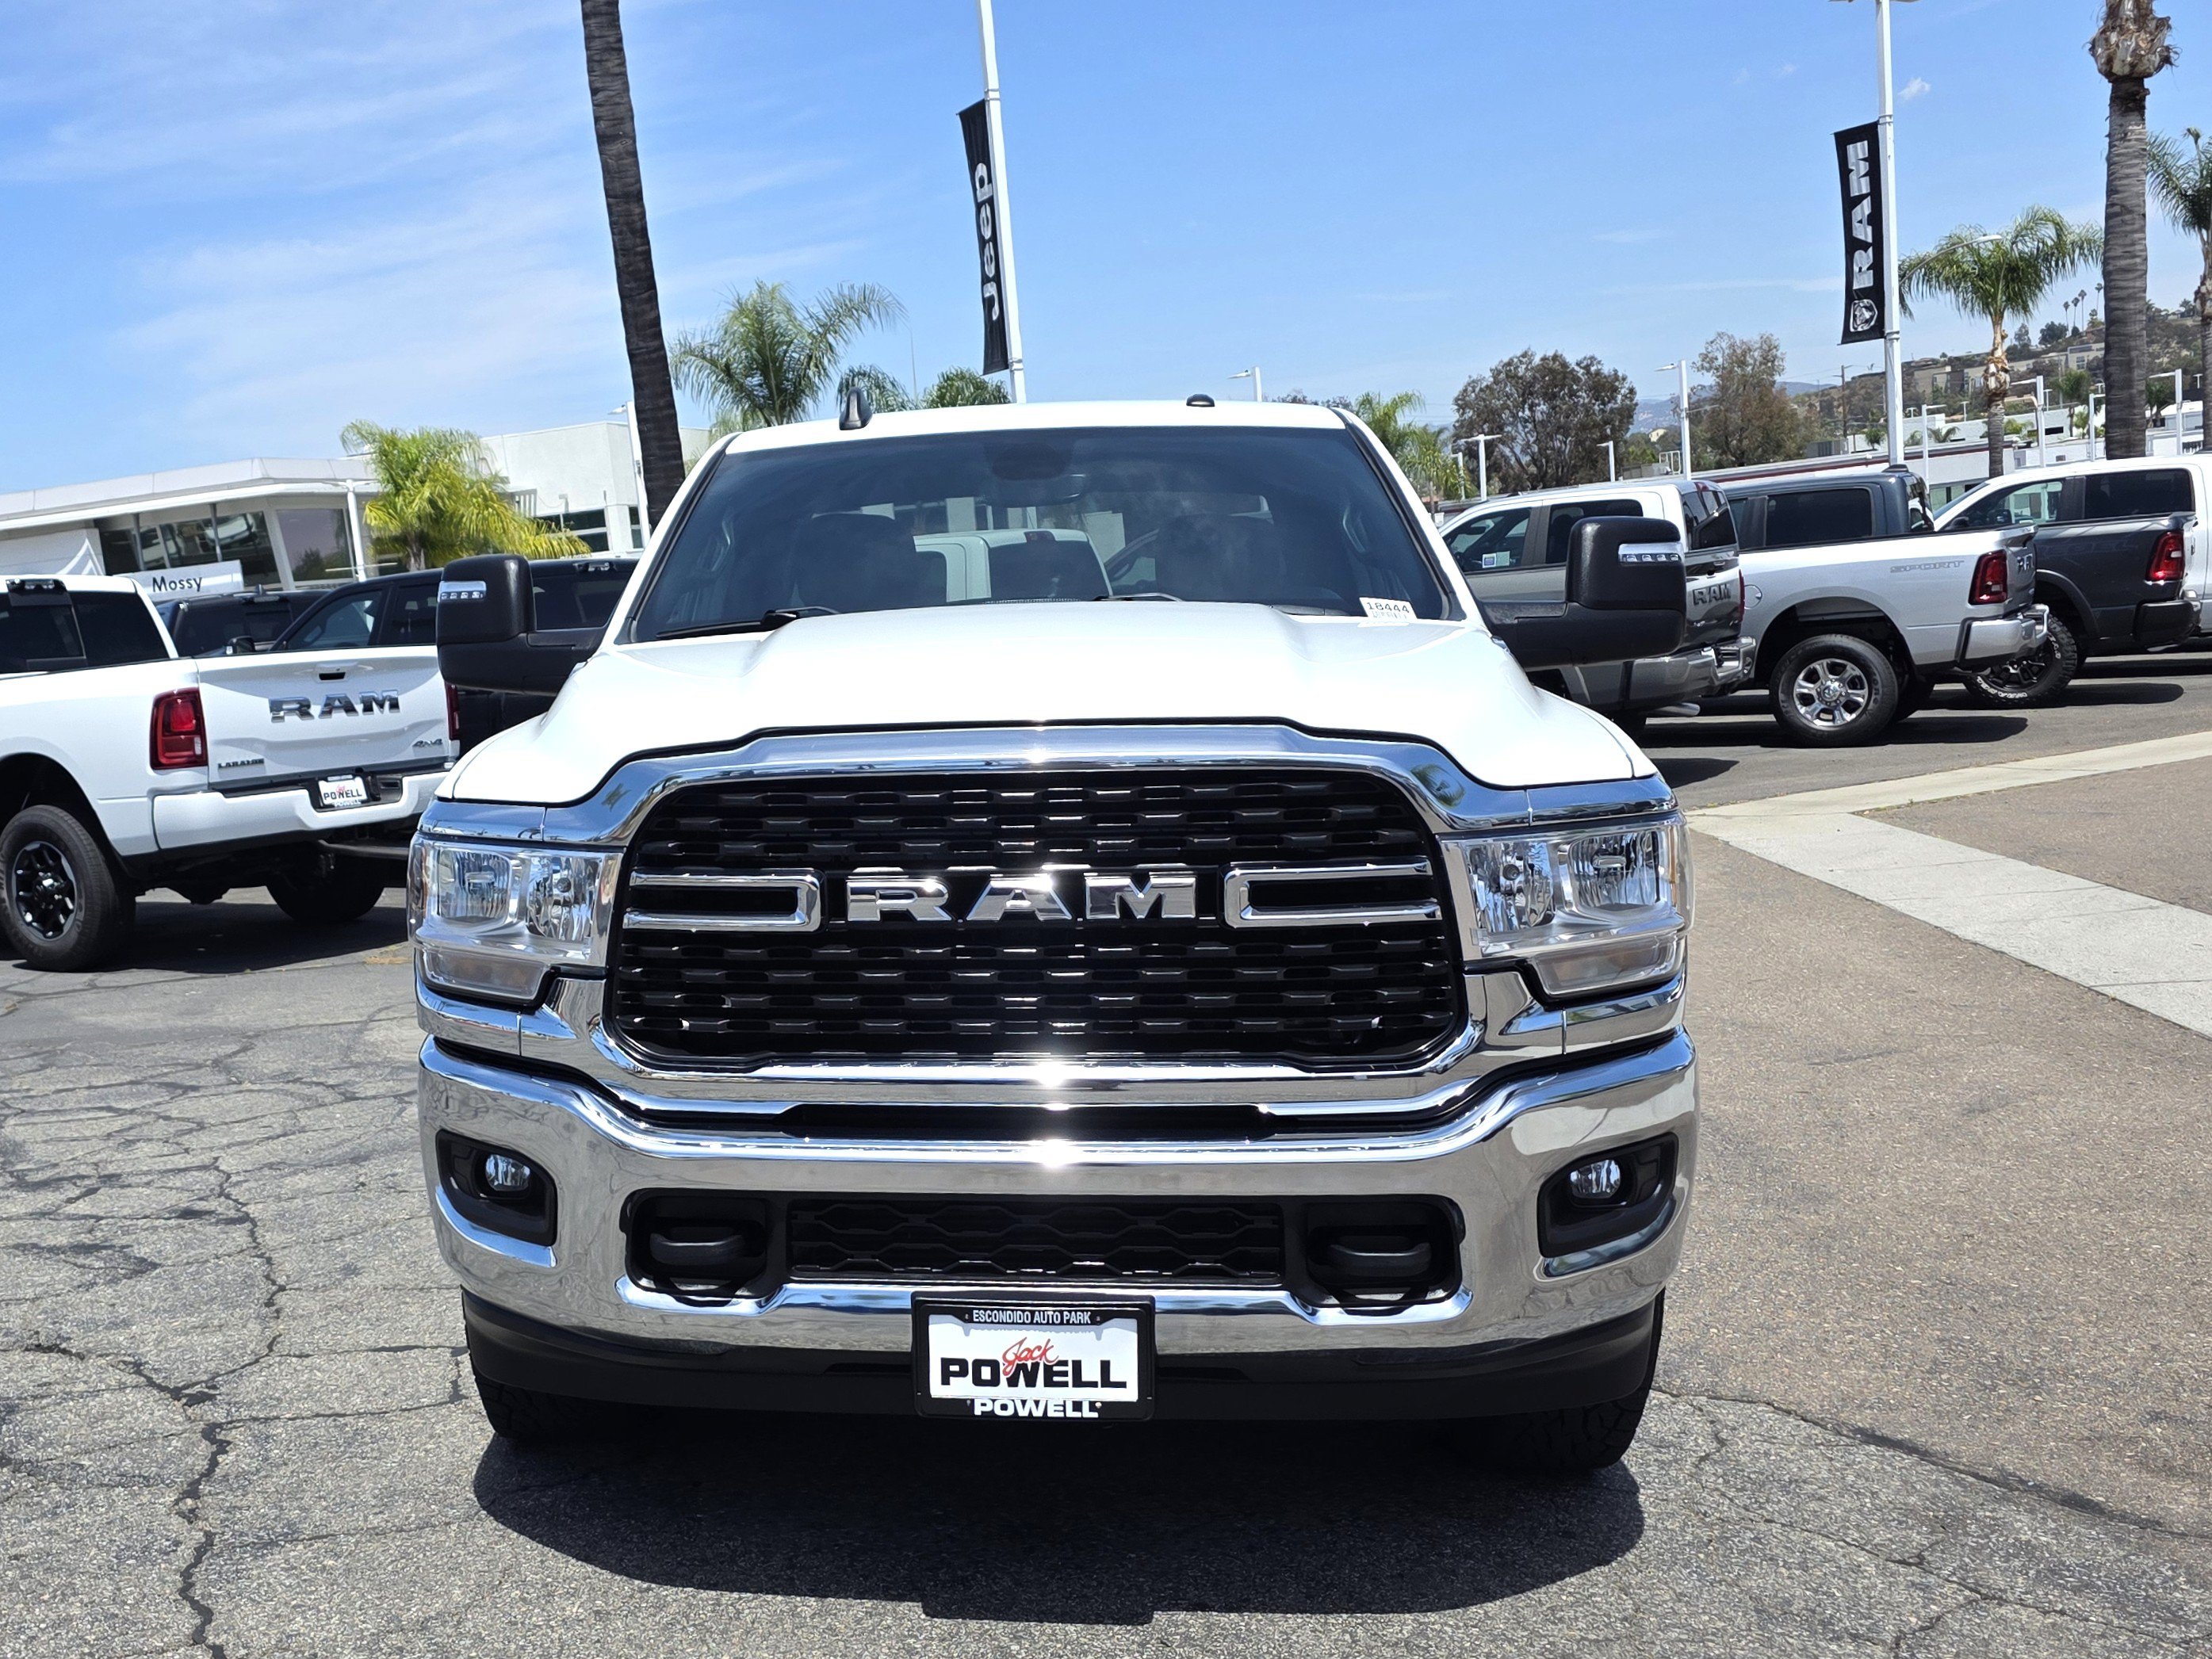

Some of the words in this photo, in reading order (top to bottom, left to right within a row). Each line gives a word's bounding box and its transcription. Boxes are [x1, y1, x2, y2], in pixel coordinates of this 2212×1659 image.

[1847, 140, 1873, 290] RAM
[975, 162, 1000, 321] Jeep
[1890, 560, 1965, 573] SPORT
[152, 575, 202, 592] Mossy
[1693, 583, 1732, 606] RAM
[1367, 602, 1410, 613] 18444
[269, 690, 400, 723] RAM
[323, 789, 362, 801] POWELL
[847, 873, 1197, 921] RAM
[973, 1309, 1031, 1324] ESCONDIDO
[1033, 1310, 1061, 1324] AUTO
[1063, 1311, 1091, 1324] PARK
[1002, 1337, 1059, 1376] Jack
[940, 1358, 1127, 1389] POWELL
[974, 1399, 1099, 1418] POWELL
